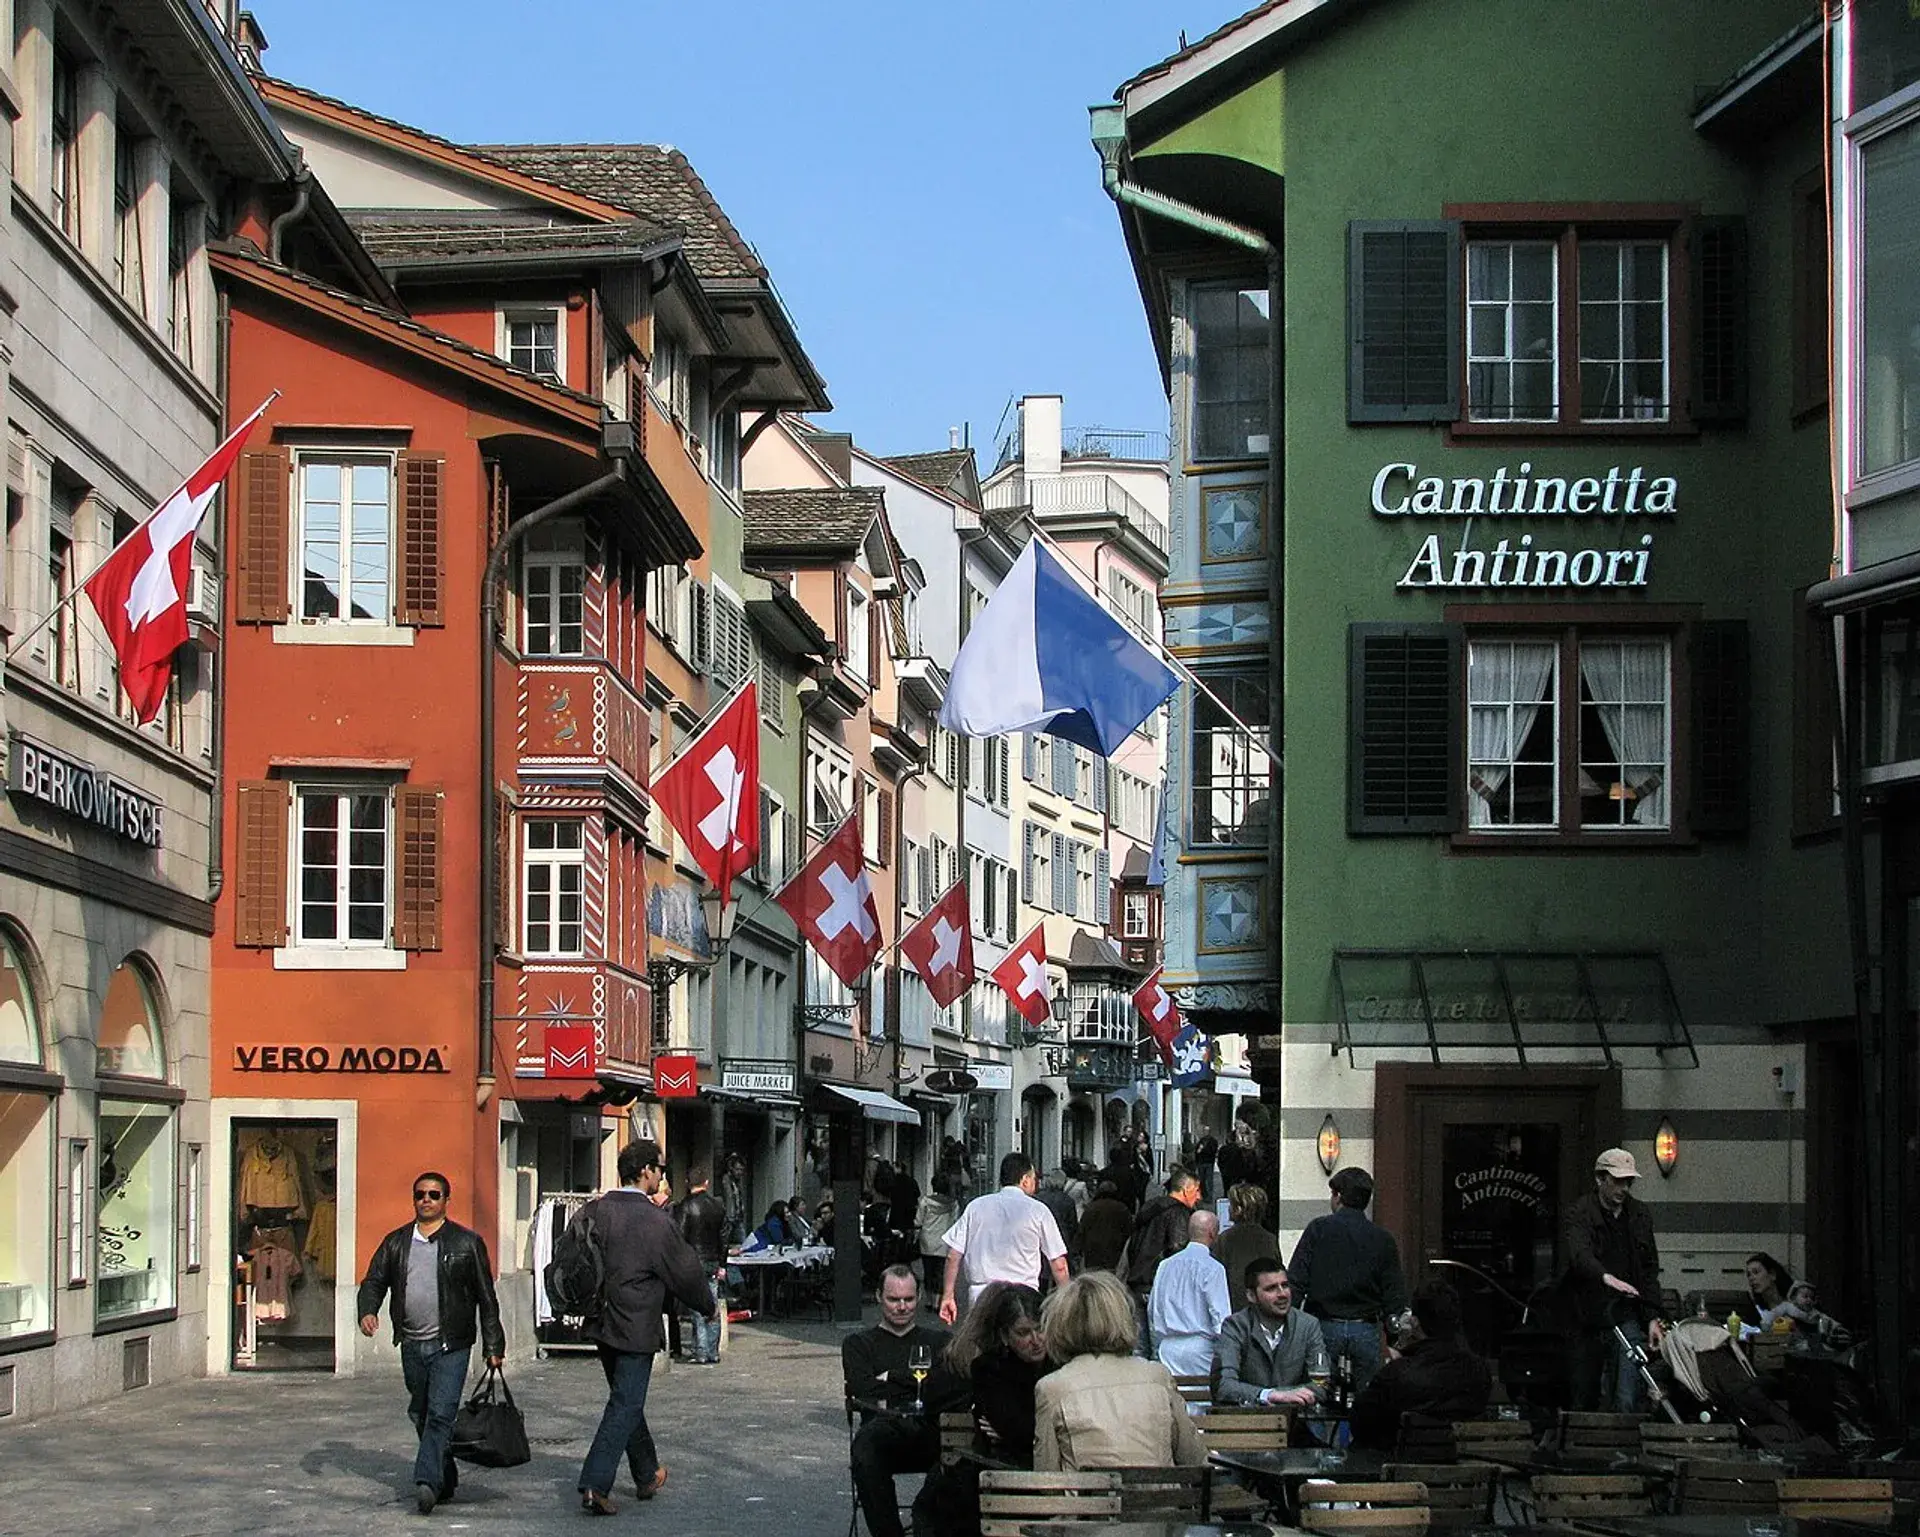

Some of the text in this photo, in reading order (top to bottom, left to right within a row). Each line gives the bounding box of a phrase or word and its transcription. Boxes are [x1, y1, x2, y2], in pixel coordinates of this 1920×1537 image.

[1371, 462, 1677, 515] Cantinetta
[1396, 534, 1653, 587] Antinori
[21, 745, 164, 848] BERKOWITSCH
[236, 1046, 444, 1072] VERO MODA
[726, 1074, 790, 1089] JUICE MARKET
[1454, 1164, 1548, 1194] Cantinetta
[1459, 1182, 1542, 1211] Antinori
